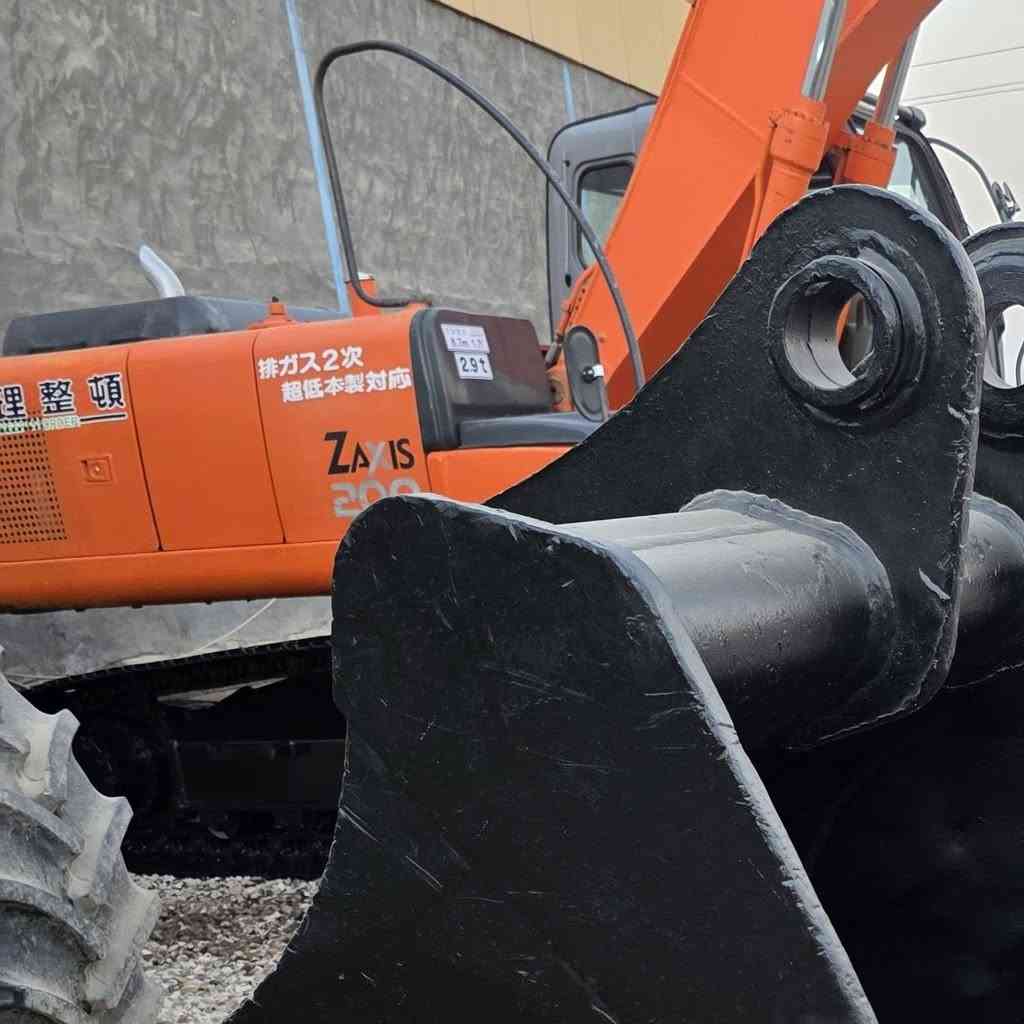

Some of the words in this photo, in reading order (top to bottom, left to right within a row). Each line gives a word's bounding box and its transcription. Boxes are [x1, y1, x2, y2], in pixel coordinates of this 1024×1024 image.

[257, 346, 364, 379] 排ガス2次
[324, 431, 415, 475] ZAXIS
